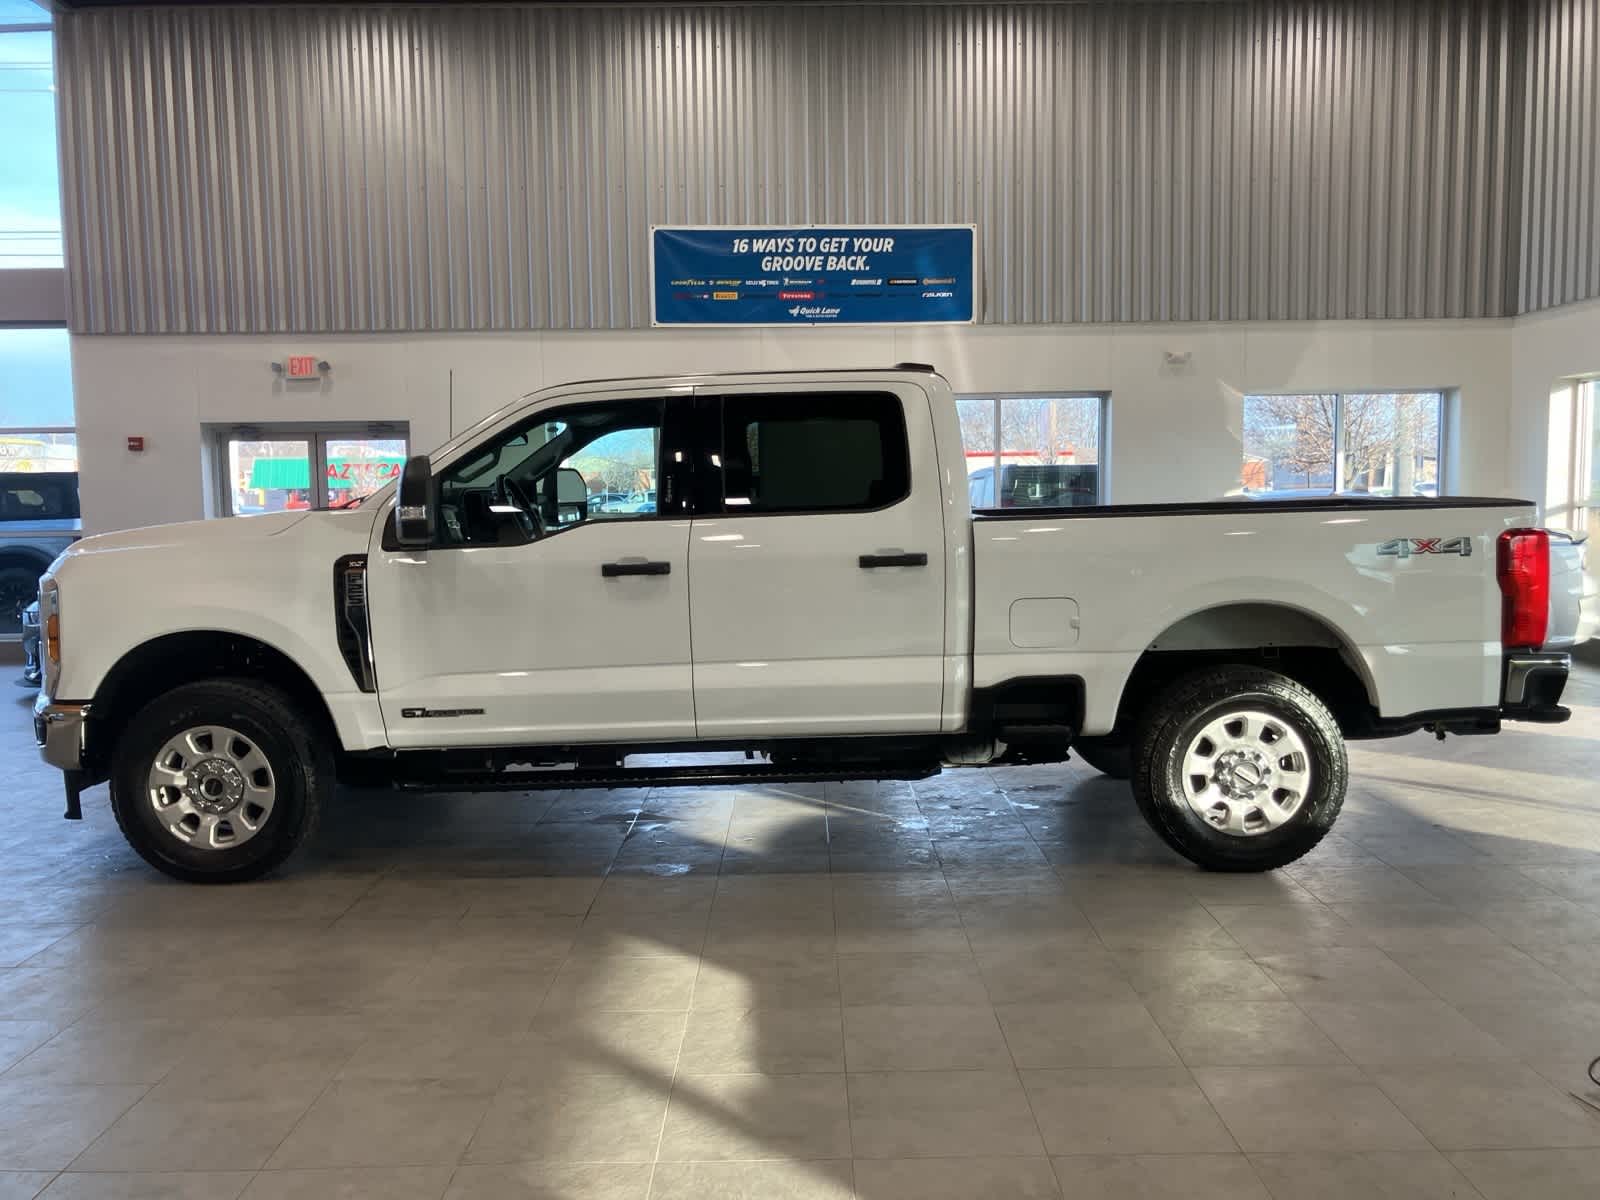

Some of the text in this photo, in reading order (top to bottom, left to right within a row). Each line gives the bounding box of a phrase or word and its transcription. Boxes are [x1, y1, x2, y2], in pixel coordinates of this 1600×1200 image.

[732, 237, 895, 253] 16 WAYS TO GET YOUR
[761, 255, 870, 272] GROOVE BACK.
[799, 307, 841, 315] Quick Lane
[290, 357, 313, 376] EXIT
